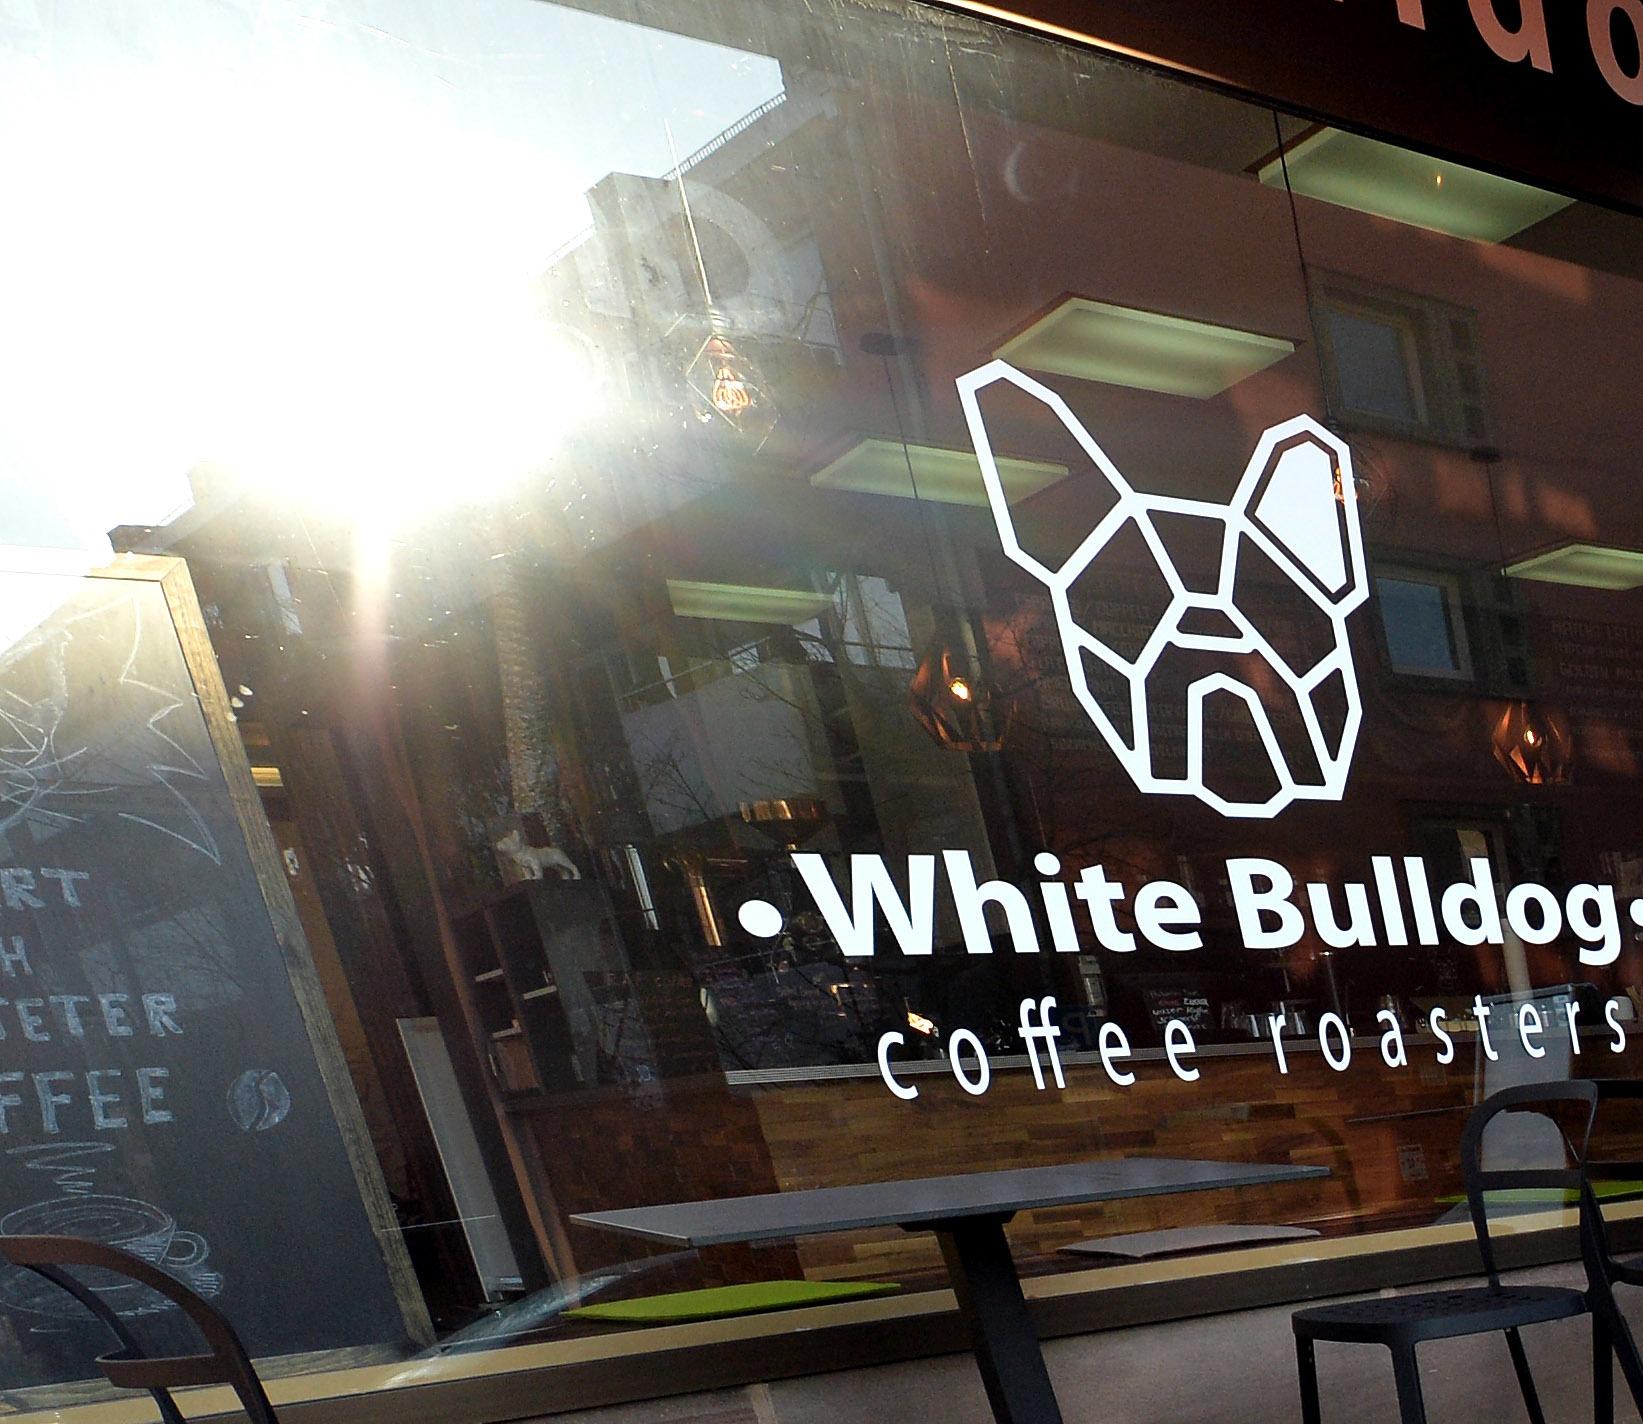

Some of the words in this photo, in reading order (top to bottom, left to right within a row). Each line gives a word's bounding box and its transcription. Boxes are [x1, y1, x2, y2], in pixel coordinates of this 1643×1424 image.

[790, 849, 1202, 957] White
[1225, 855, 1625, 964] Bulldog
[0, 992, 184, 1042] ETER
[876, 996, 1201, 1101] coffee
[1271, 991, 1629, 1076] roasters
